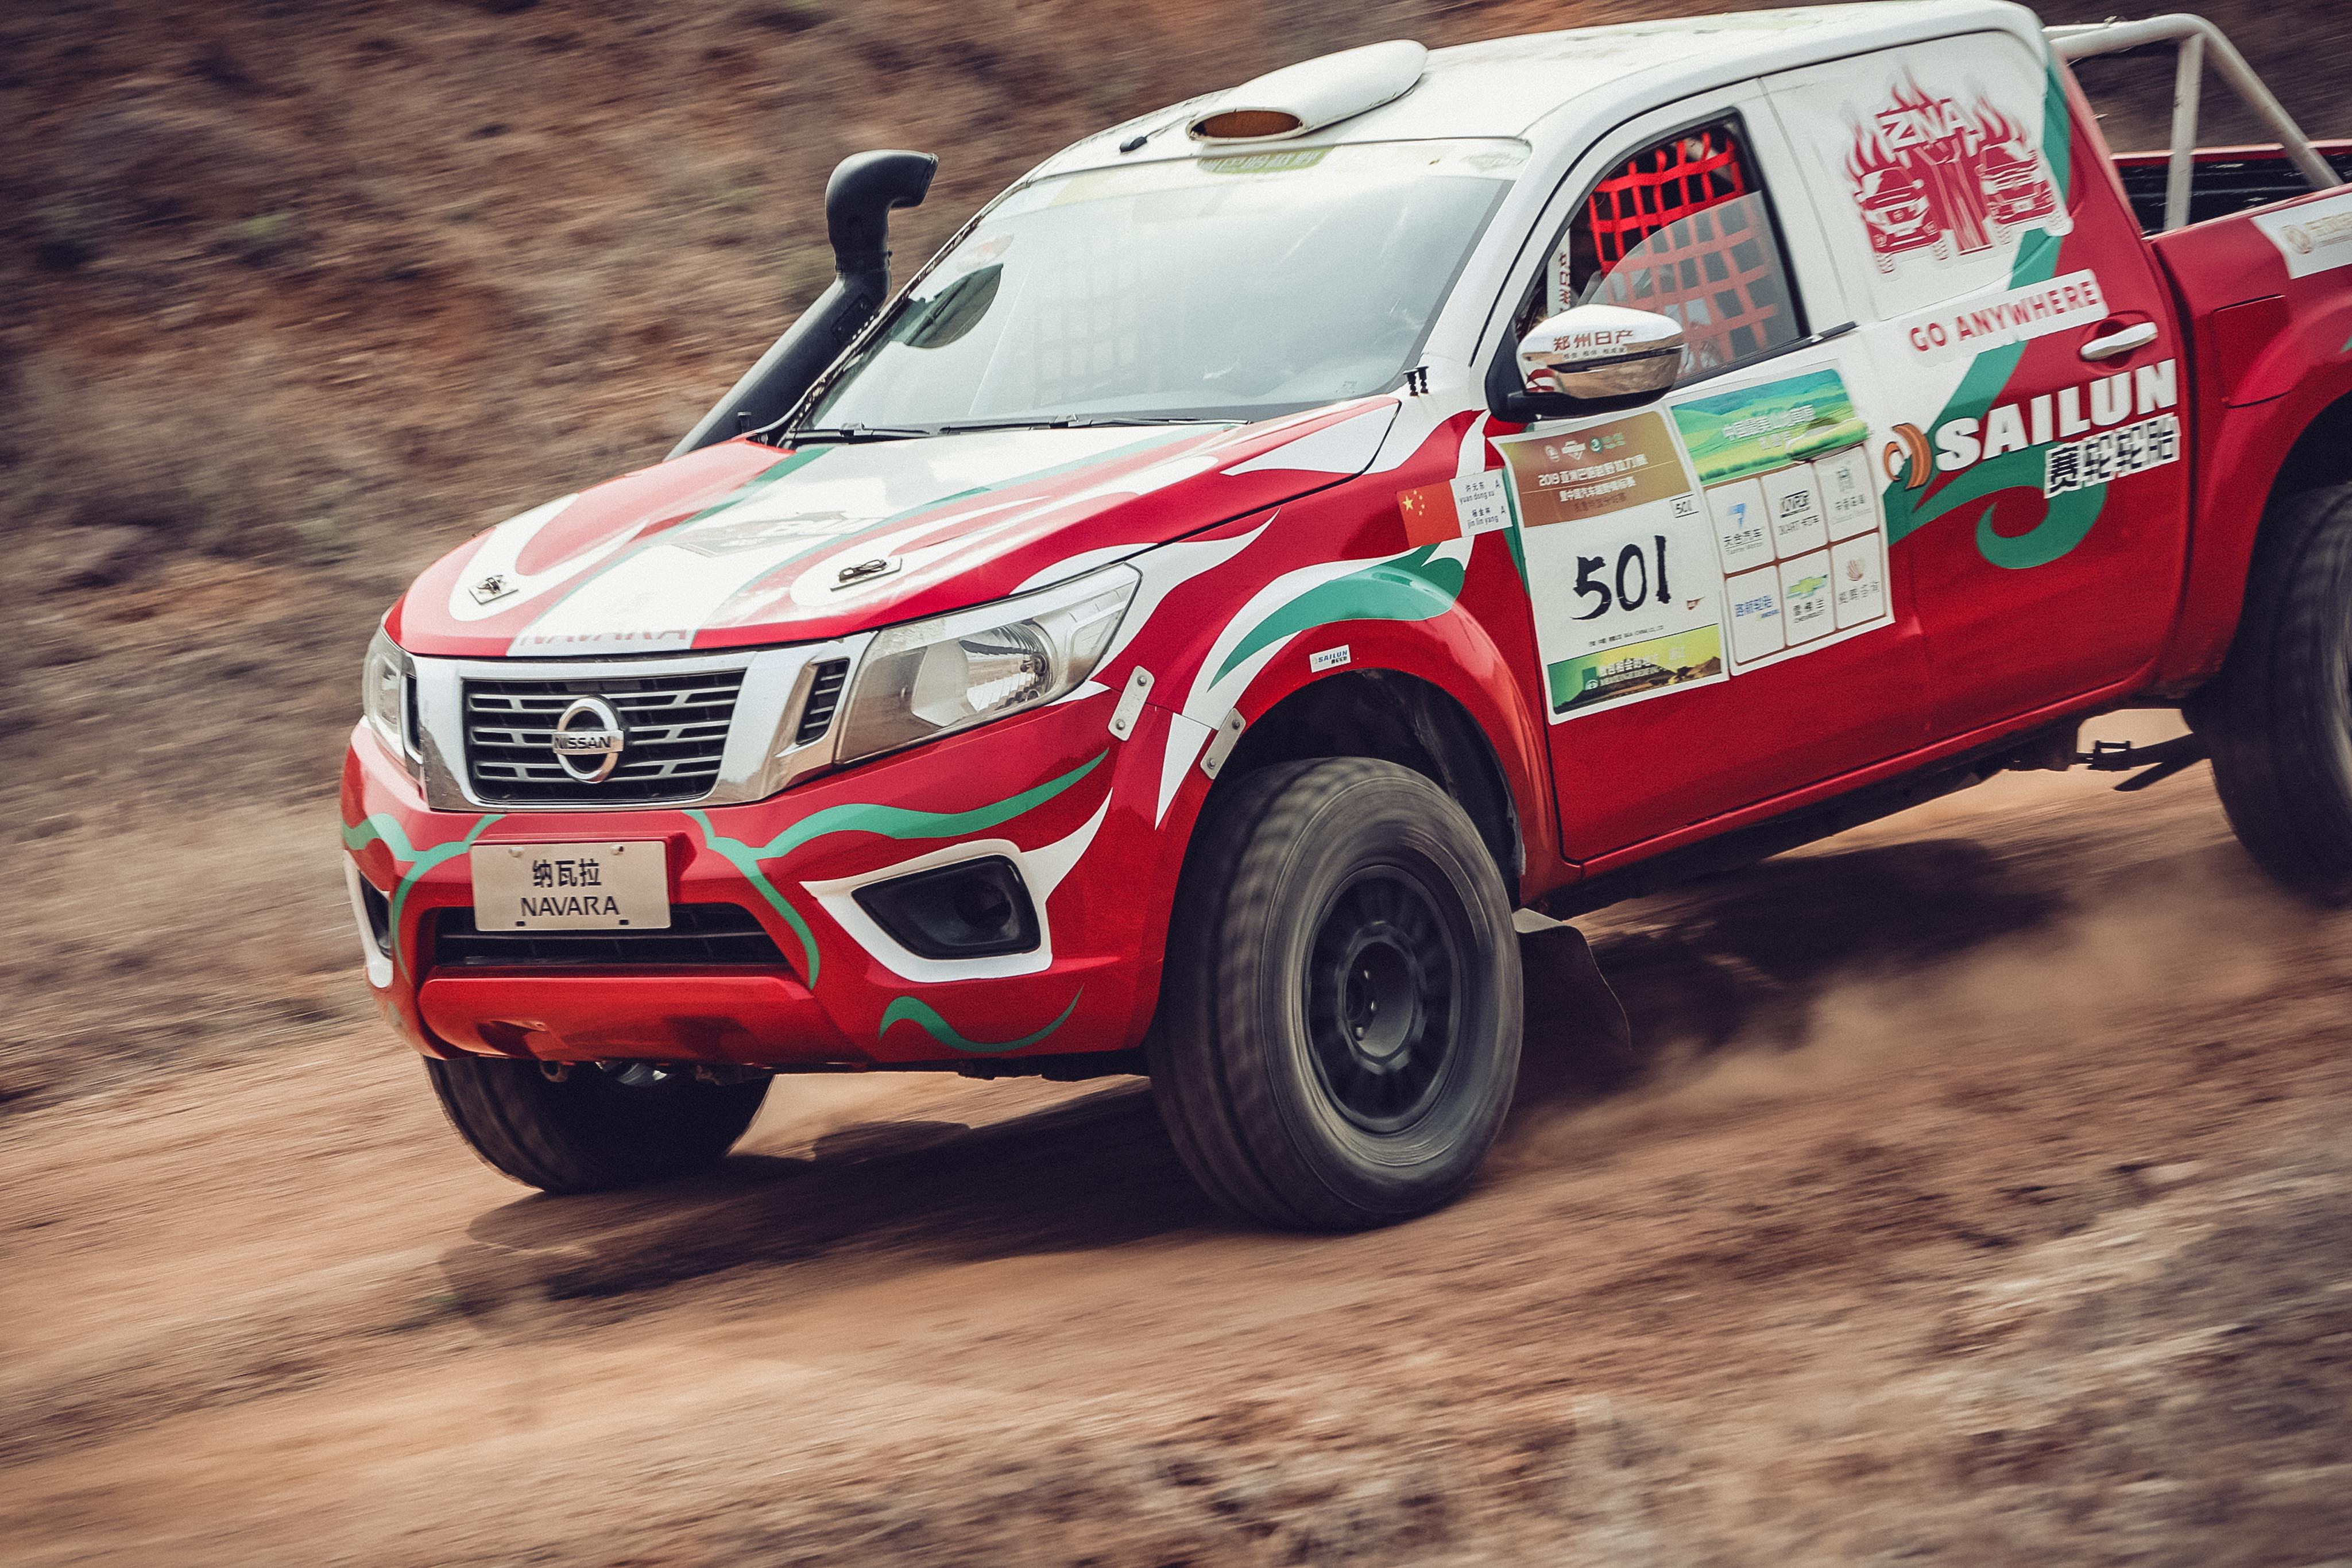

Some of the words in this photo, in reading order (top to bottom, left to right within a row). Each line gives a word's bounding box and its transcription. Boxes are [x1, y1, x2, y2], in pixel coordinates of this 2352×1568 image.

[1875, 102, 1982, 150] ZNA
[1909, 323, 1948, 351] GO
[1955, 281, 2098, 342] ANYWHERE
[1553, 330, 1634, 351] 郑州日产
[1935, 359, 2178, 471] SAILUN
[2047, 416, 2179, 495] 赛轮轮胎
[1570, 535, 1671, 620] 501
[1318, 650, 1347, 663] SAILUN
[555, 736, 612, 749] NISSAN
[533, 858, 602, 888] 纳瓦拉
[521, 896, 620, 916] NAVARA
